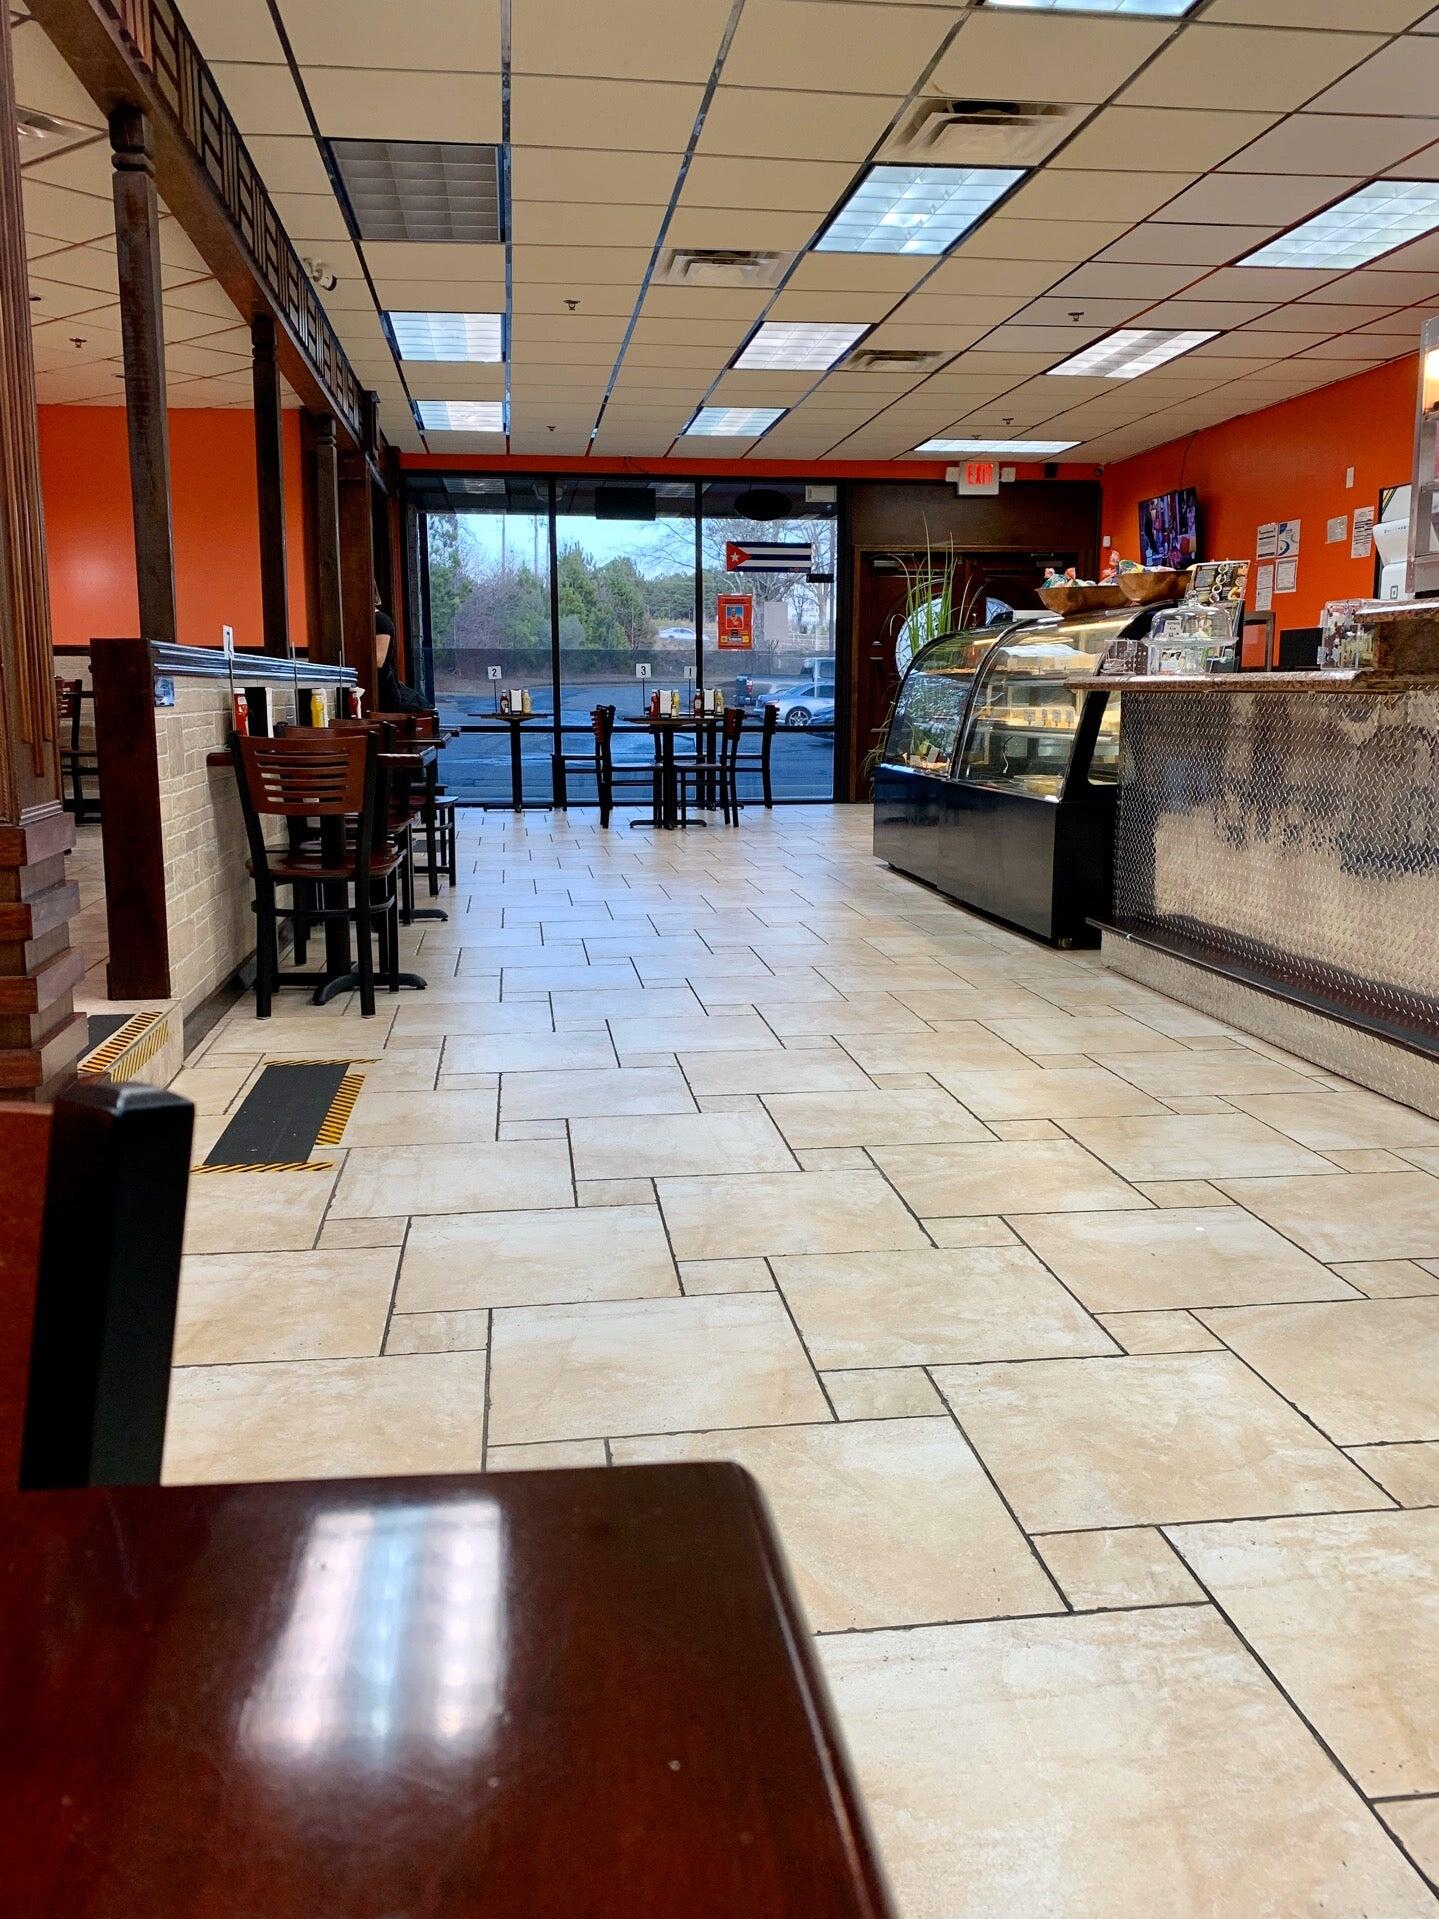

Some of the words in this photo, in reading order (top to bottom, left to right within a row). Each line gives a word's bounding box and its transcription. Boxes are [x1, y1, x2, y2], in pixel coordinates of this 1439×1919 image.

[966, 463, 994, 486] EXIT
[491, 668, 498, 678] 2
[640, 665, 647, 676] 3
